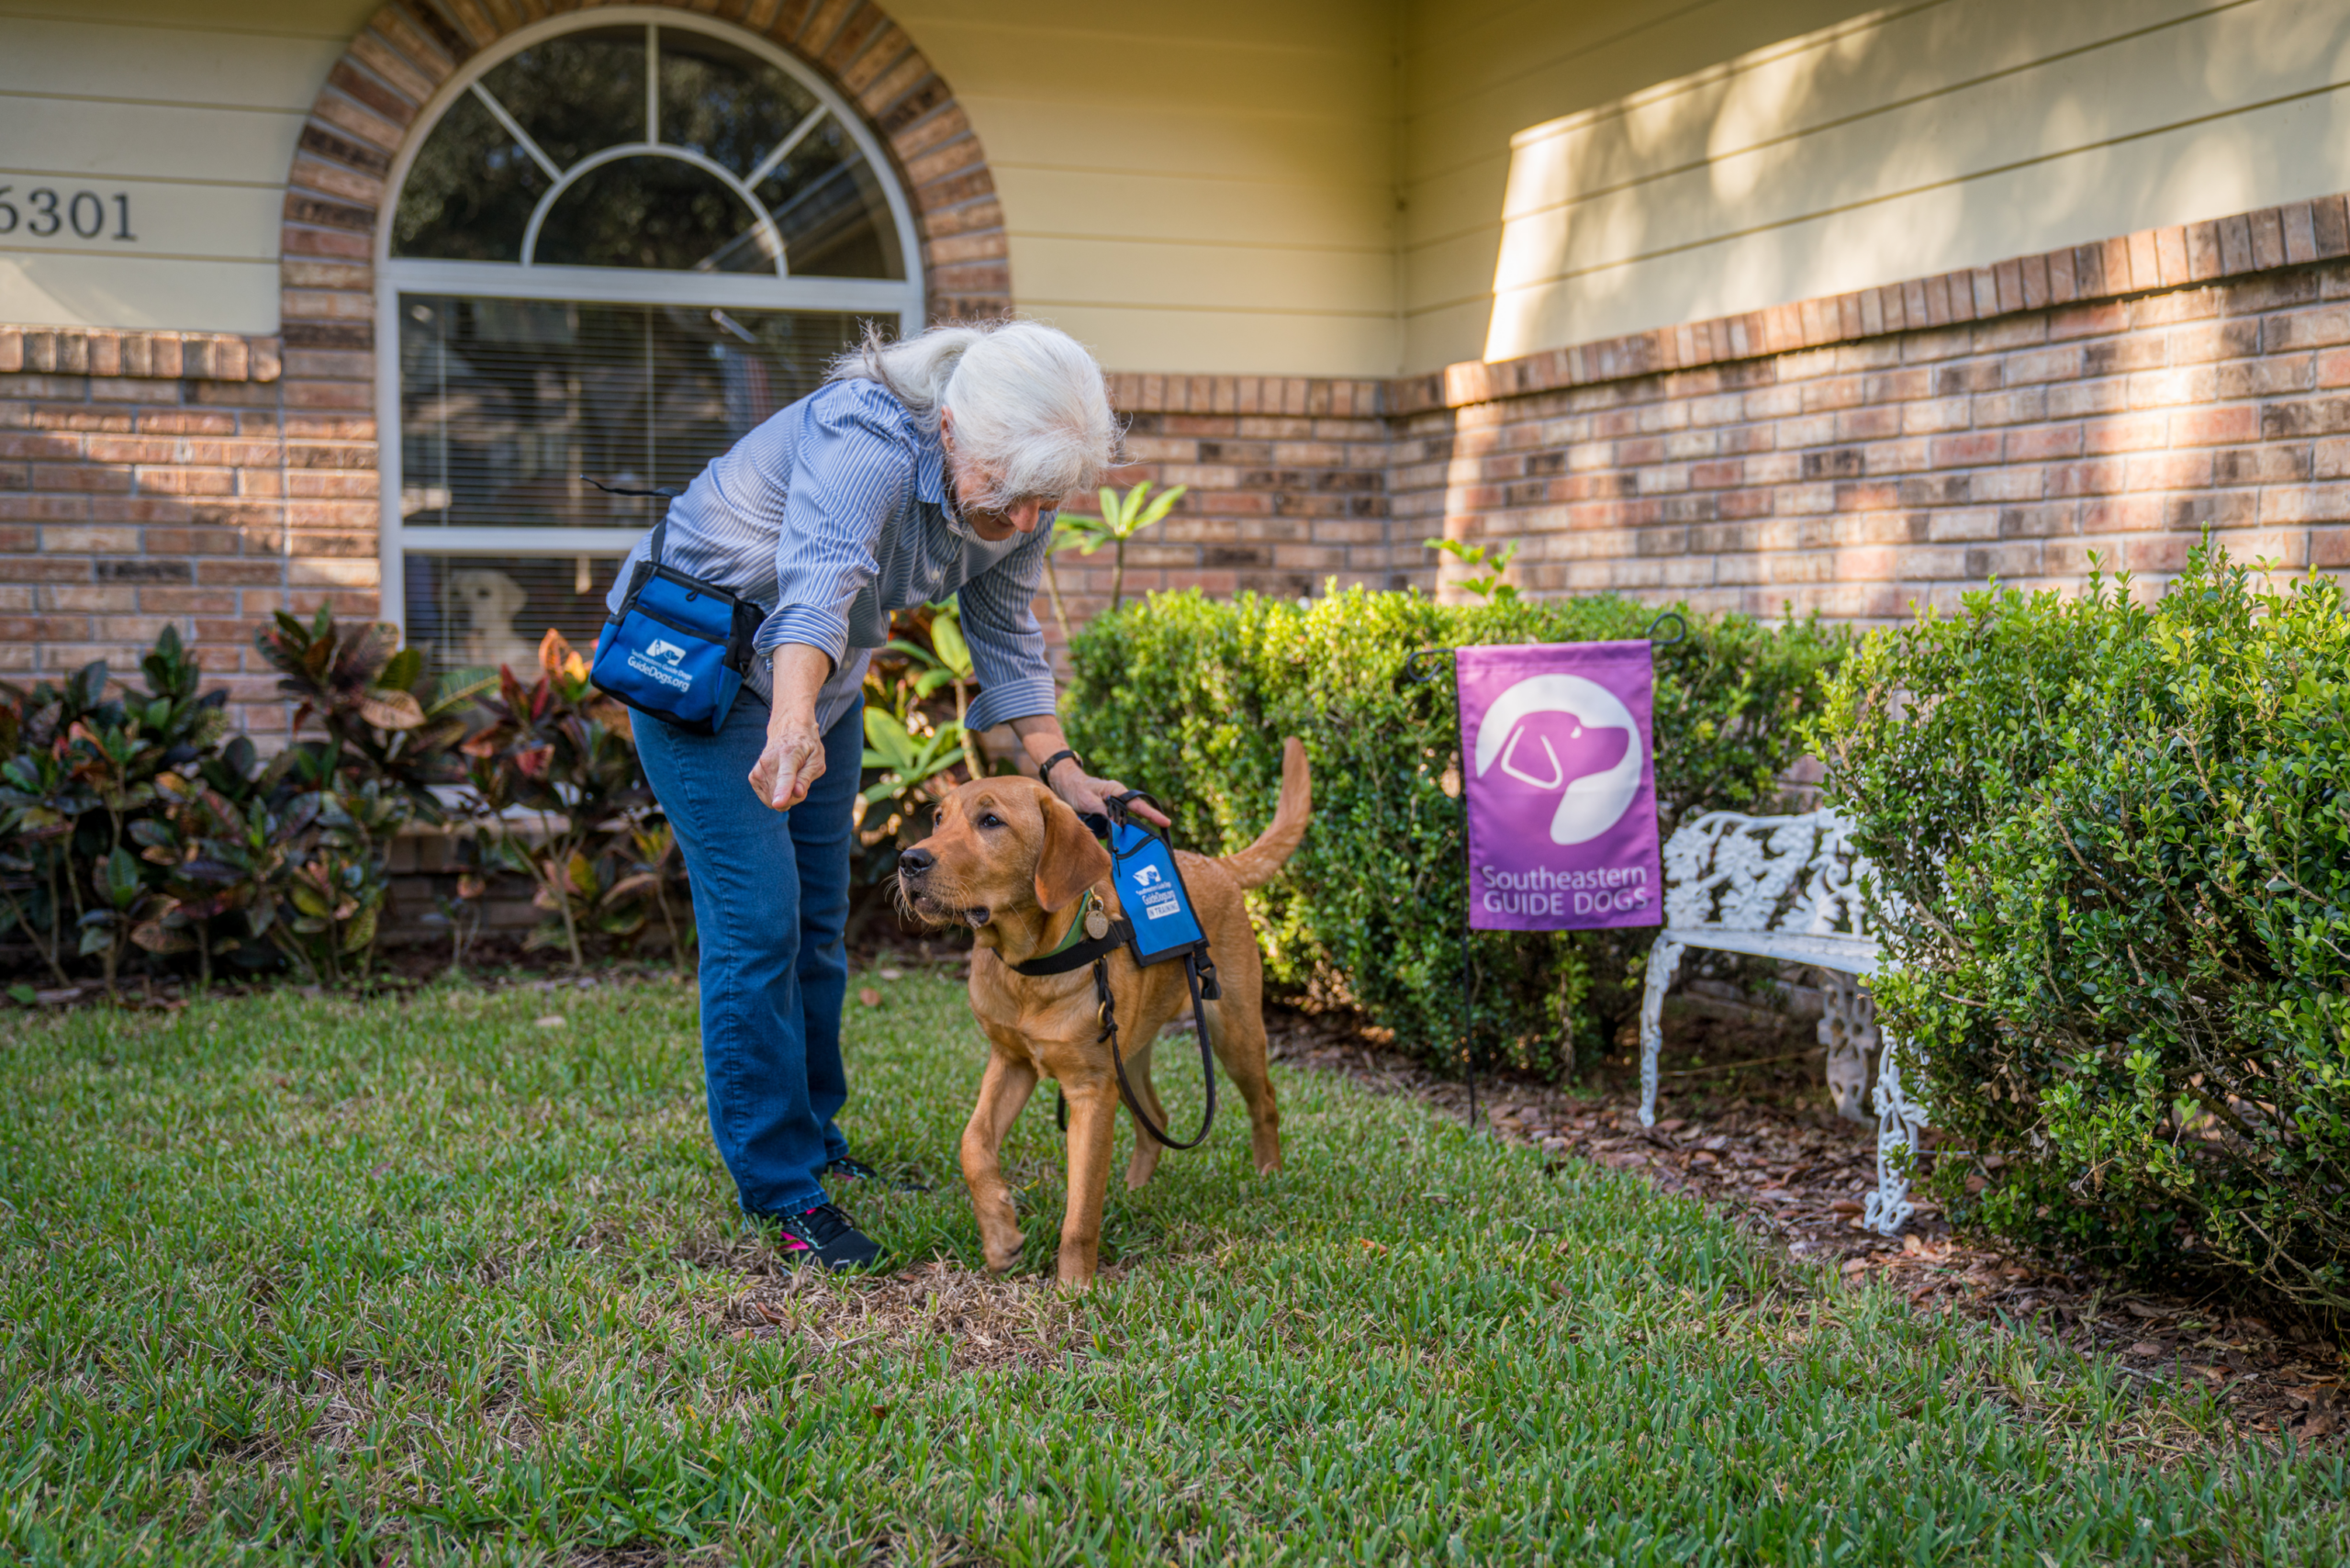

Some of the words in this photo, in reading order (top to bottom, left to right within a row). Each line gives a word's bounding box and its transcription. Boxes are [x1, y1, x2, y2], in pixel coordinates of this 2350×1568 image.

[627, 655, 690, 693] GuideDogs.org
[662, 664, 677, 675] Guide
[678, 670, 692, 680] Dogs
[1483, 865, 1647, 890] Southeastern
[1142, 890, 1176, 906] GuideDogs.org
[1483, 890, 1564, 916] GUIDE
[1574, 887, 1649, 915] DOGS
[1148, 909, 1155, 917] IN
[1154, 902, 1179, 916] TRAINING
